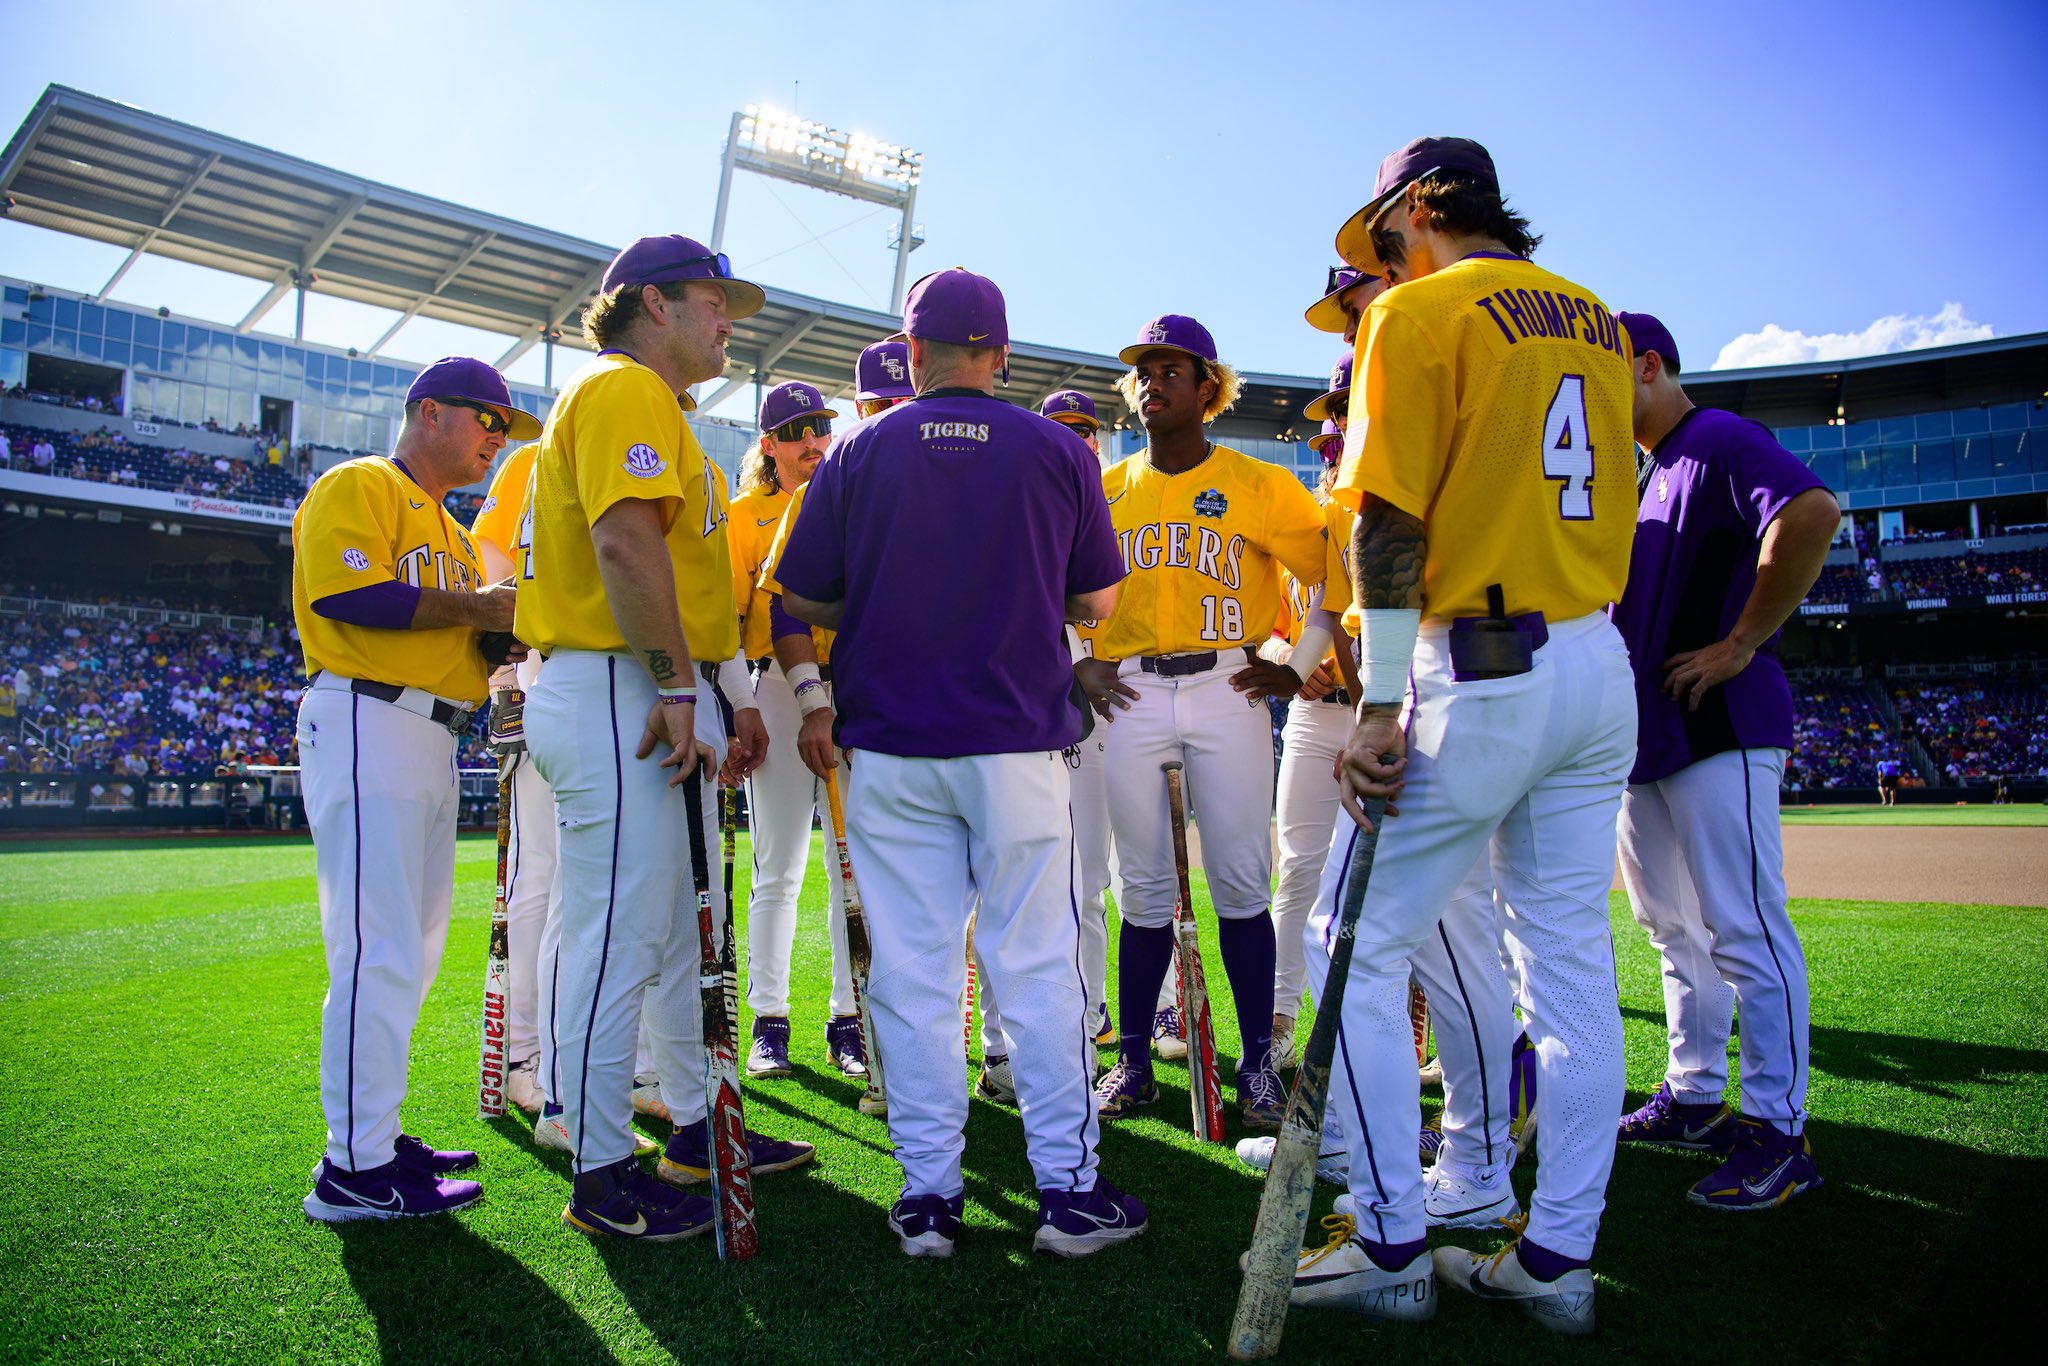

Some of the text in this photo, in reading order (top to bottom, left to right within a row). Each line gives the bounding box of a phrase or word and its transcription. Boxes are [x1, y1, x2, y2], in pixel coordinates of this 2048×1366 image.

[880, 351, 905, 381] LSU
[785, 386, 811, 407] LSU
[1061, 393, 1080, 411] LSU
[137, 424, 157, 434] 205
[920, 421, 990, 442] TIGERS
[628, 444, 658, 470] SEC
[1541, 373, 1594, 521] 4
[627, 466, 664, 478] GRADUATE
[174, 497, 293, 521] THE Greatest SHOW ON DIR
[343, 549, 370, 570] SEC
[1116, 522, 1246, 591] IGERS
[1800, 604, 1849, 615] TENNESSEE
[1906, 599, 1947, 610] VIRGINIA
[1986, 594, 2014, 605] WAKE
[1201, 595, 1245, 641] 18
[836, 1023, 858, 1032] TIGERS
[481, 991, 506, 1115] marucci
[1211, 1094, 1219, 1131] CONNECT
[723, 1104, 758, 1234] CATX
